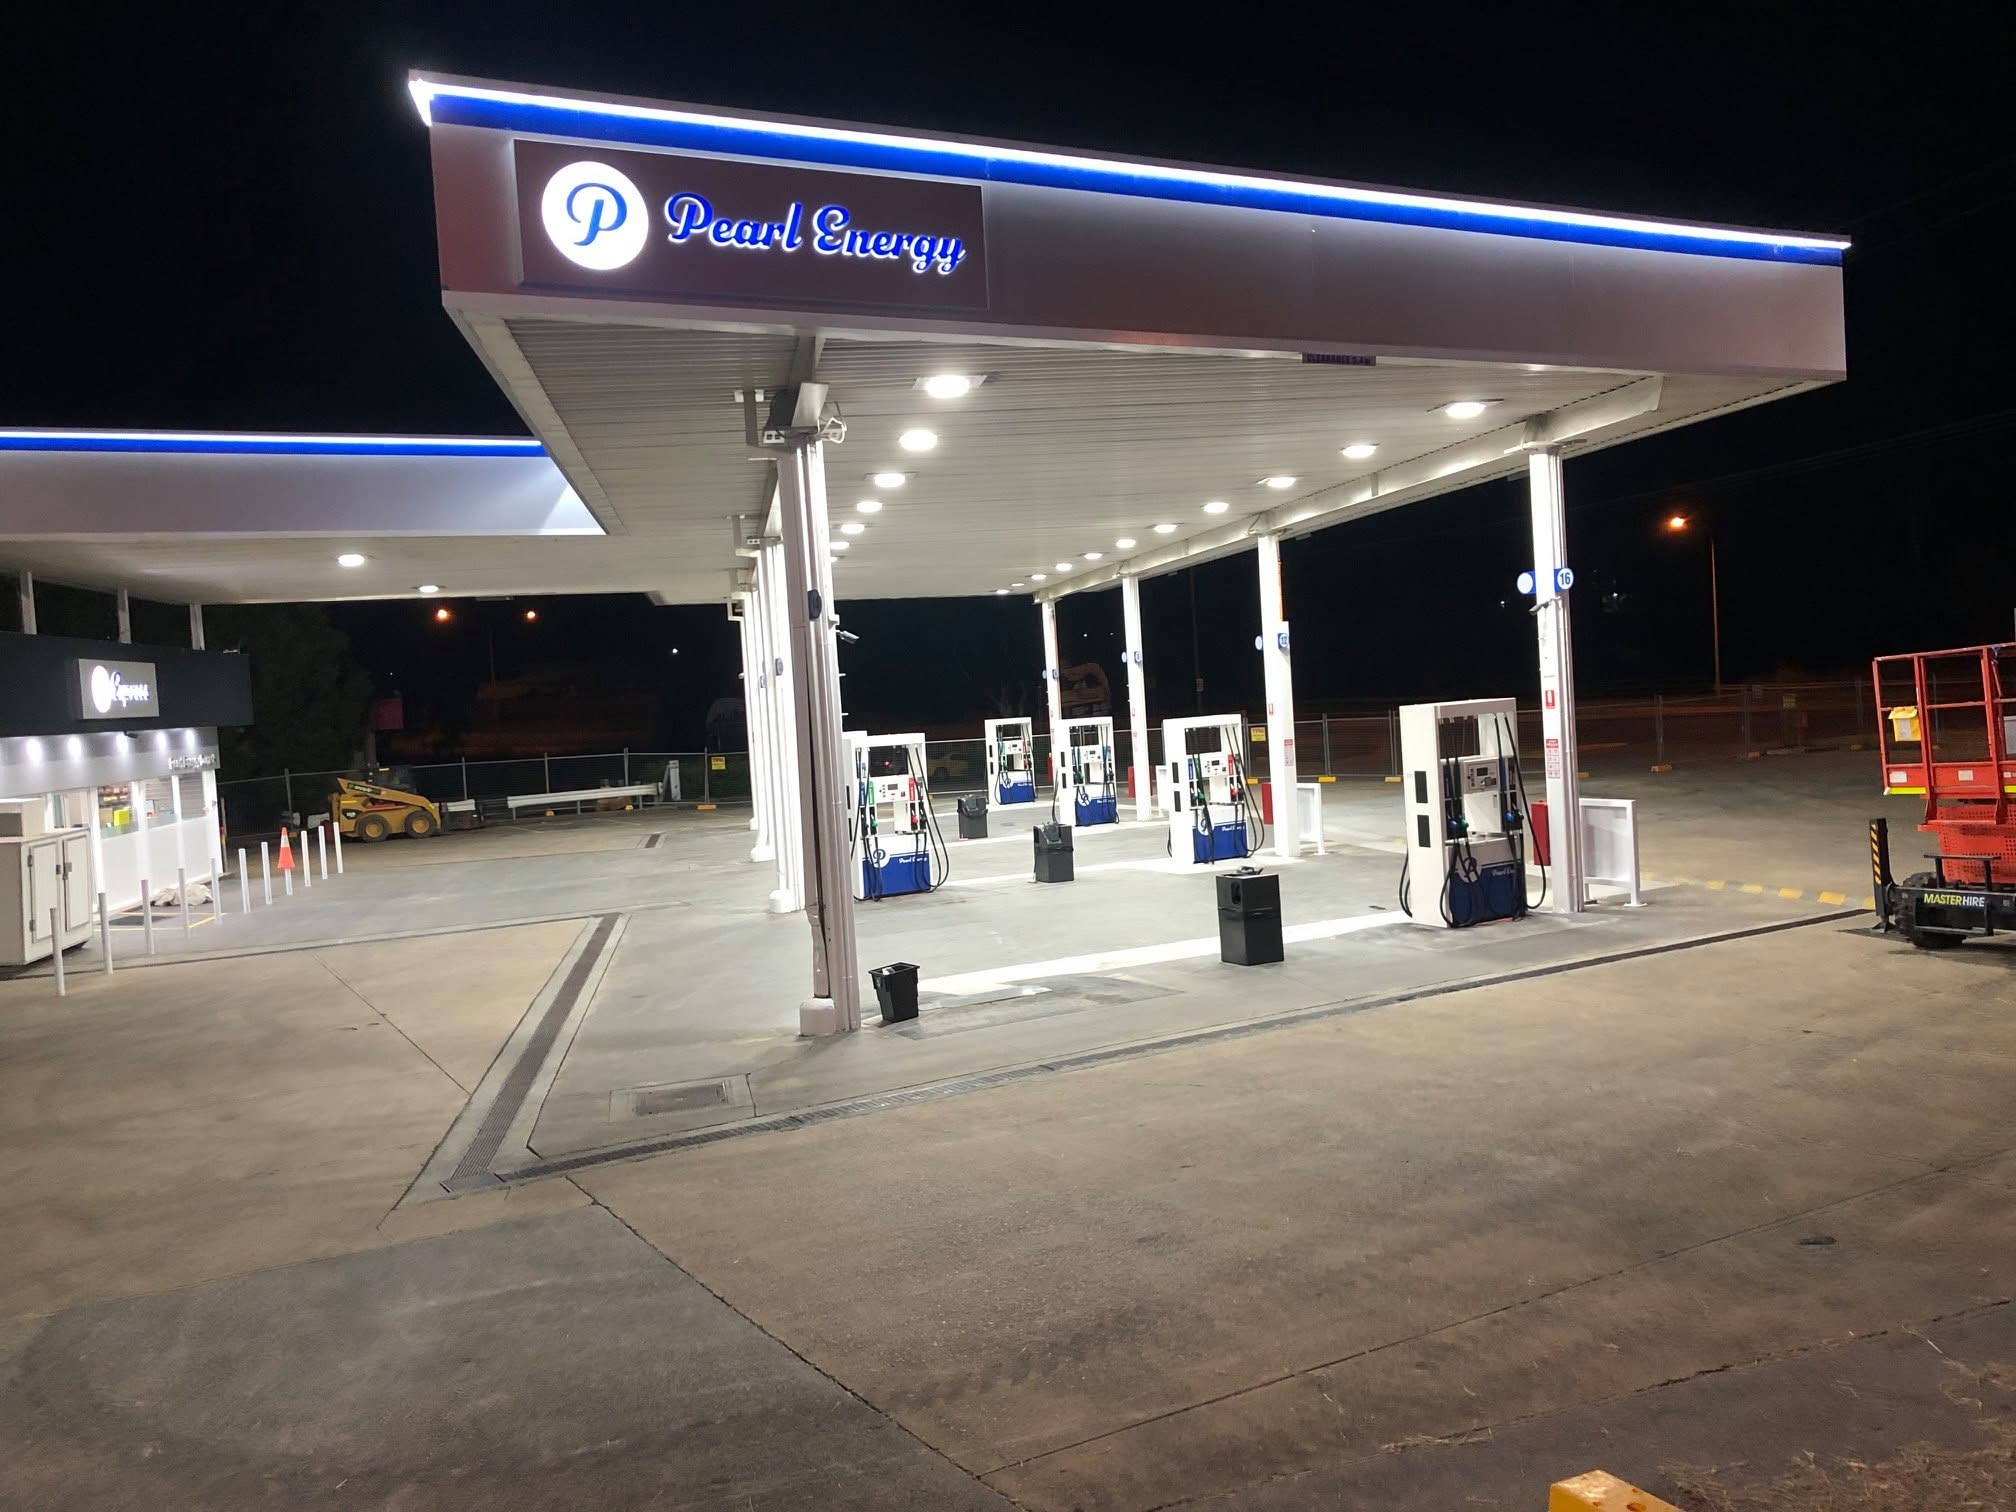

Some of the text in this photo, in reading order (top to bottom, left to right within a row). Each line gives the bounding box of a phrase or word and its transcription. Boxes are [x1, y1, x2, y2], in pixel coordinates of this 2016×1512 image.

[566, 182, 628, 246] P
[664, 191, 966, 275] Pearl Energy
[1560, 572, 1571, 585] 16
